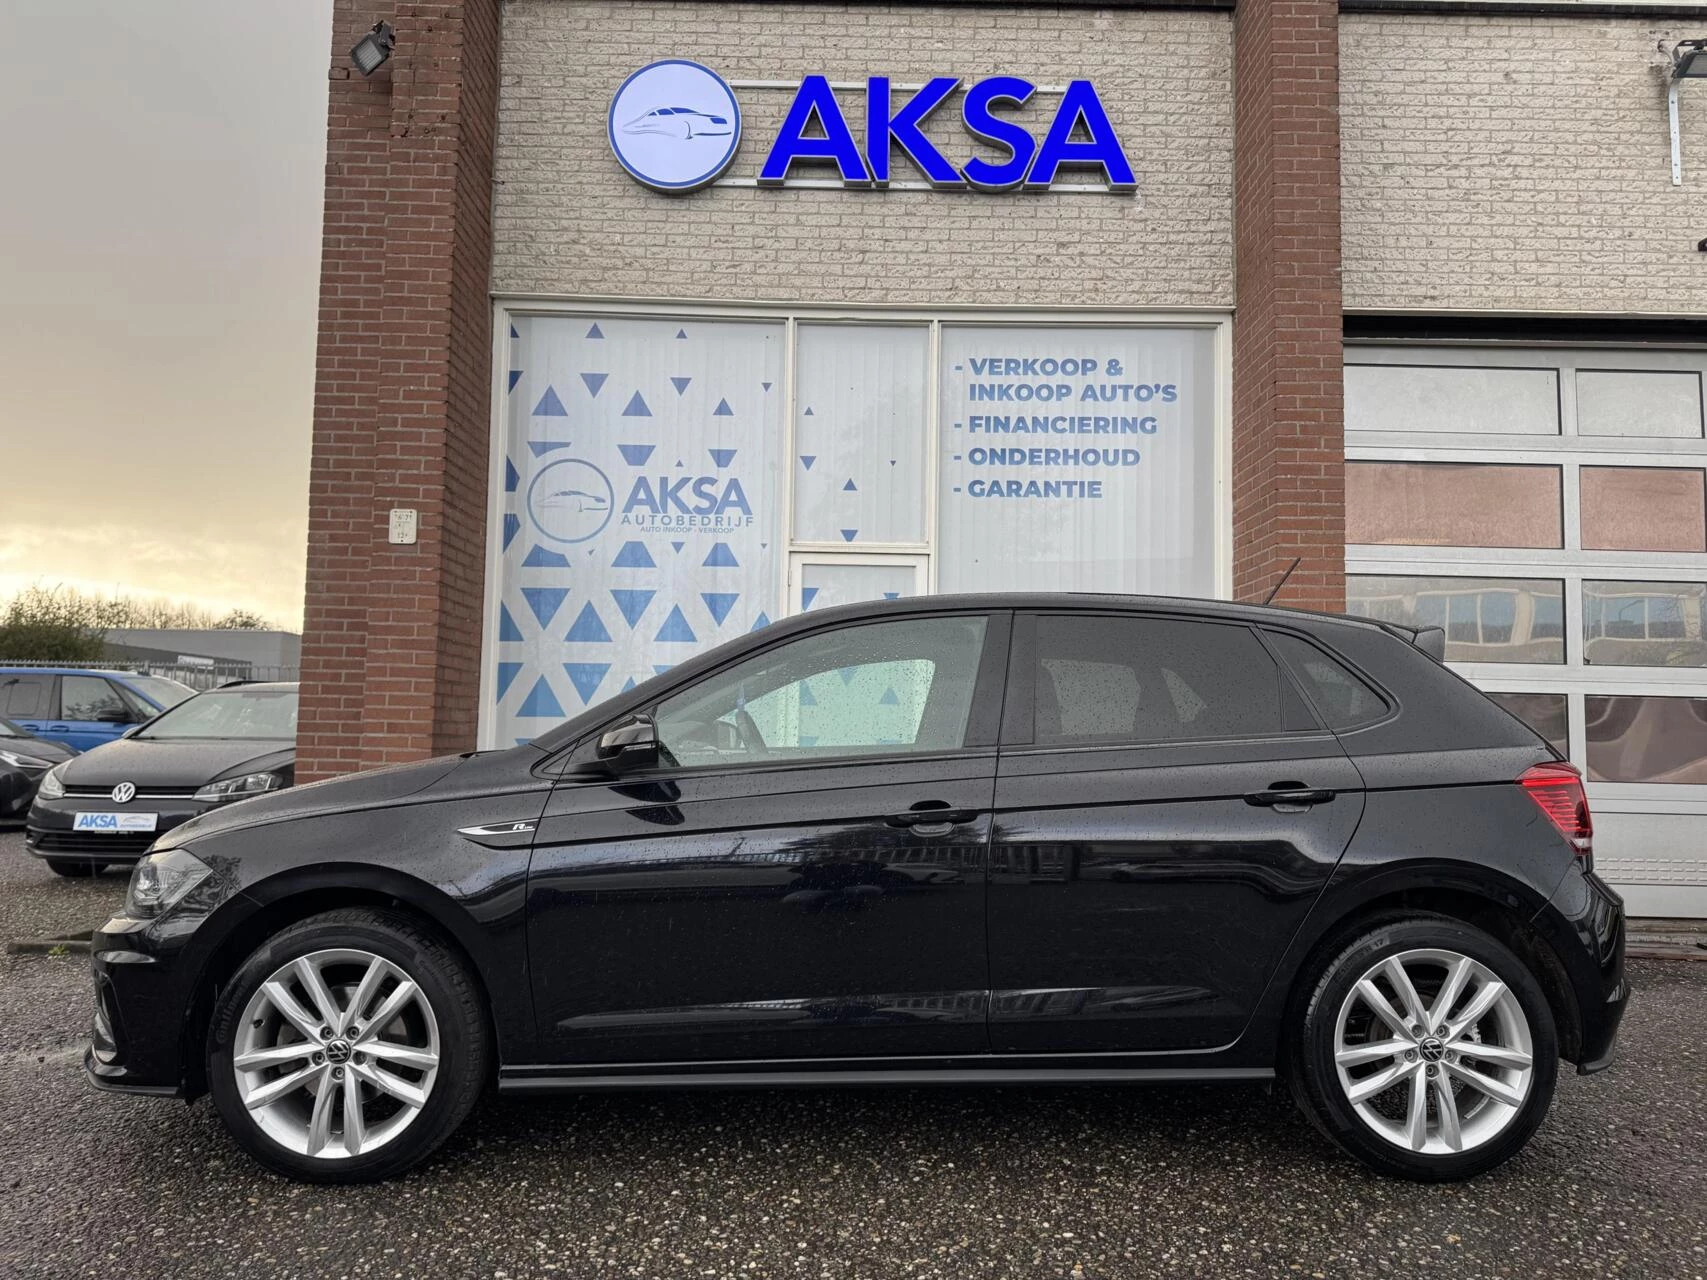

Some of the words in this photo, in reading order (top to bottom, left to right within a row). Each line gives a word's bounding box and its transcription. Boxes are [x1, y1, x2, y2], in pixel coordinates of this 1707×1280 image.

[757, 75, 1138, 192] AKSA
[969, 358, 1098, 376] VERKOOP
[1105, 358, 1123, 376] &
[969, 383, 1072, 402] INKOOP
[1080, 383, 1178, 402] AUTO'S
[969, 416, 1157, 434] FINANCIERING
[968, 448, 1141, 466] ONDERHOUD
[621, 475, 753, 515] AKSA
[968, 480, 1103, 498] GARANTIE
[621, 514, 754, 527] AUTOBEDRIJF
[662, 526, 692, 534] INKOOP
[78, 814, 118, 828] AKSA
